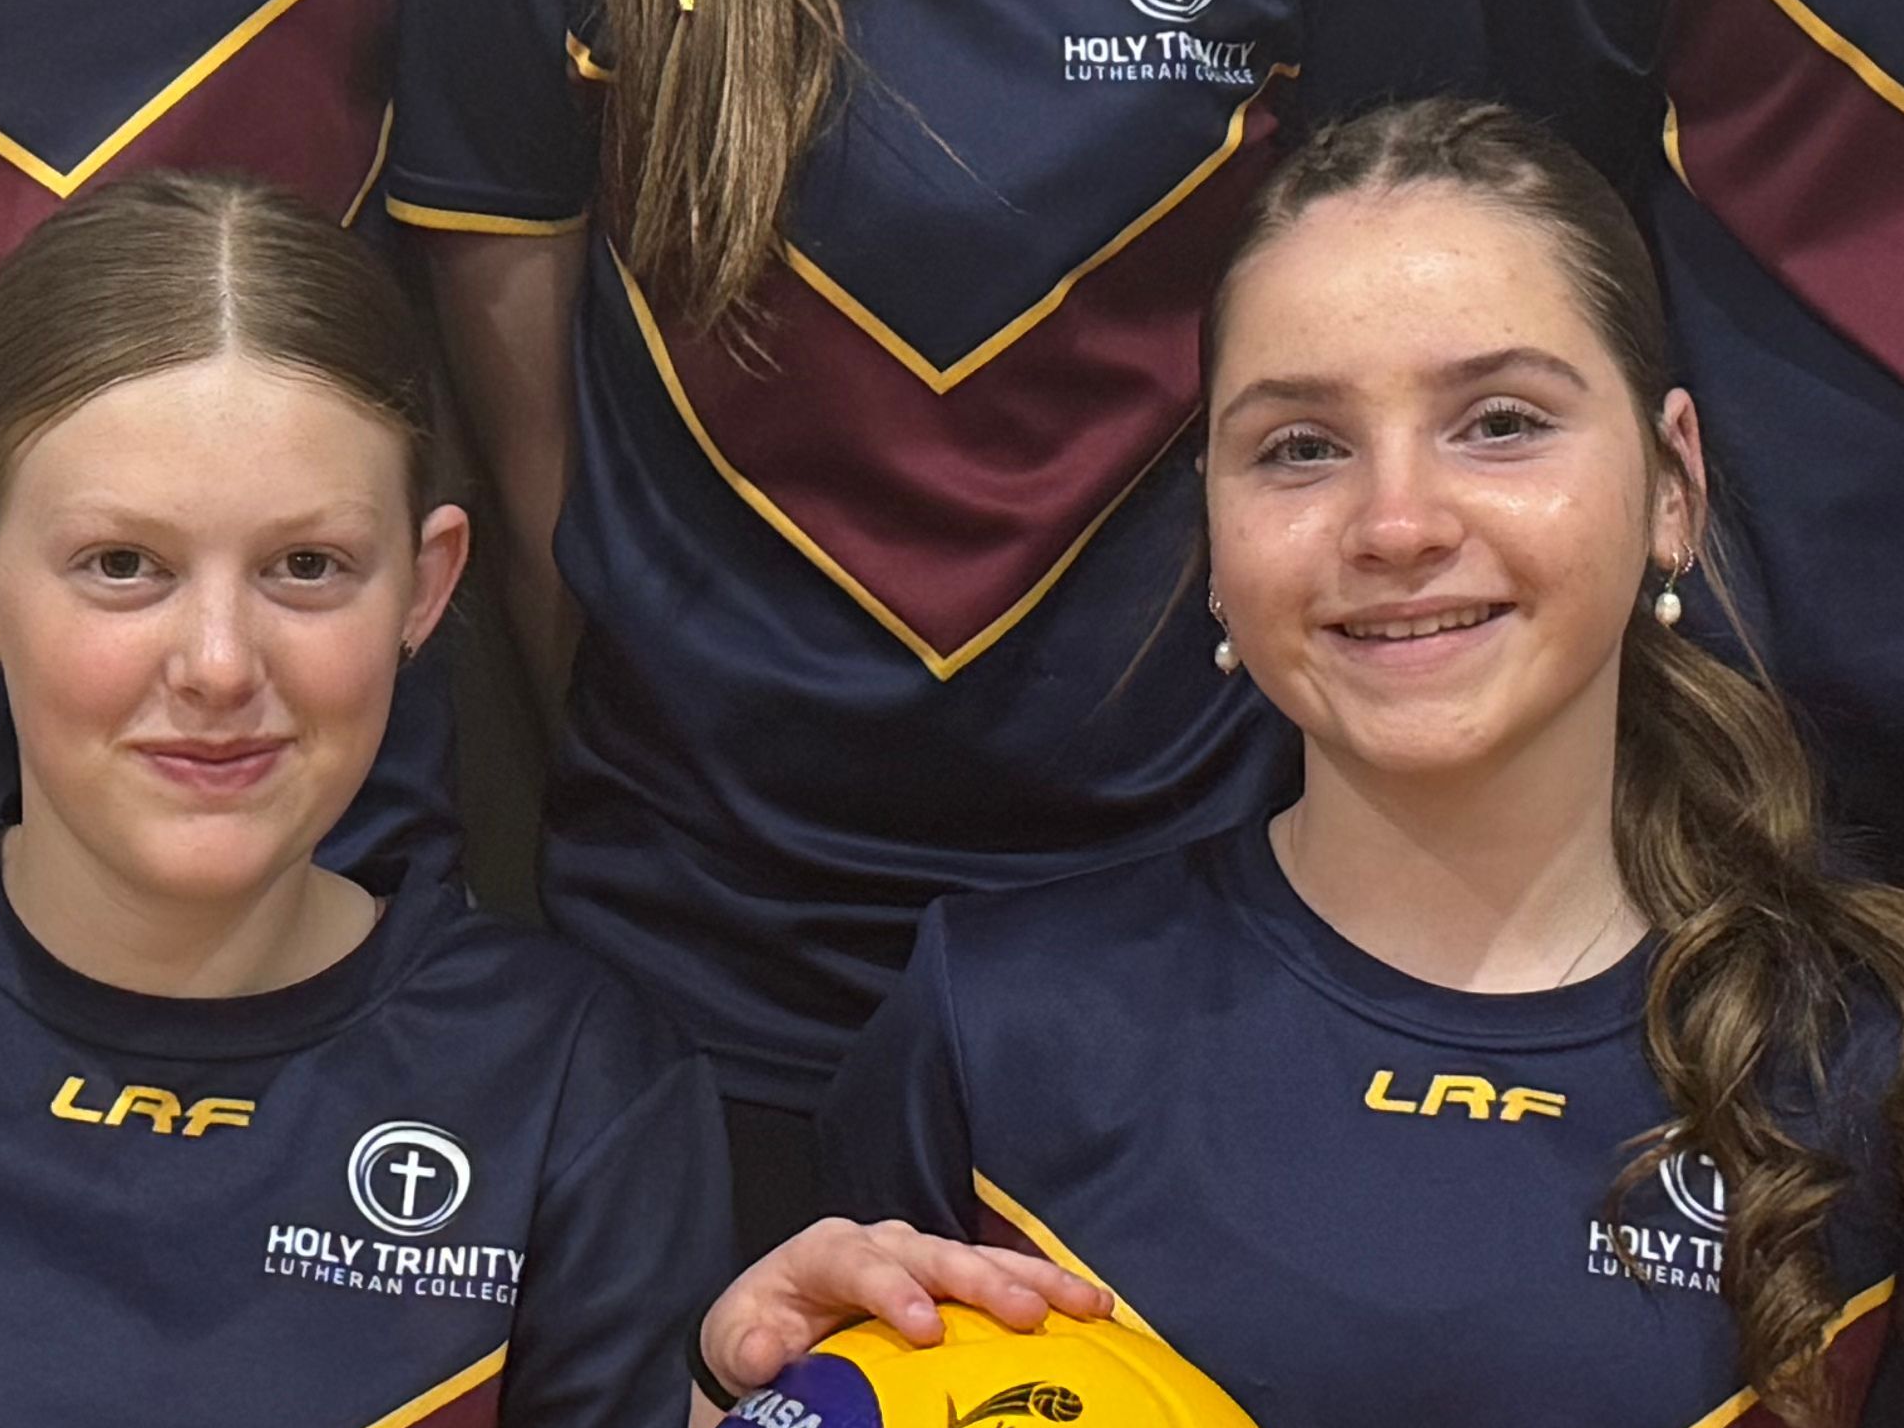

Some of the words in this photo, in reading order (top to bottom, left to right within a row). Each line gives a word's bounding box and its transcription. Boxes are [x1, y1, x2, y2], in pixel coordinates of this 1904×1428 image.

[1063, 34, 1148, 63] HOLY
[1064, 62, 1188, 81] LUTHERAN
[50, 1075, 256, 1138] LRF
[1364, 1069, 1567, 1122] LRF
[266, 1224, 365, 1267] HOLY
[372, 1241, 526, 1284] TRINITY
[1588, 1219, 1682, 1263] HOLY
[263, 1255, 404, 1296] LUTHERAN
